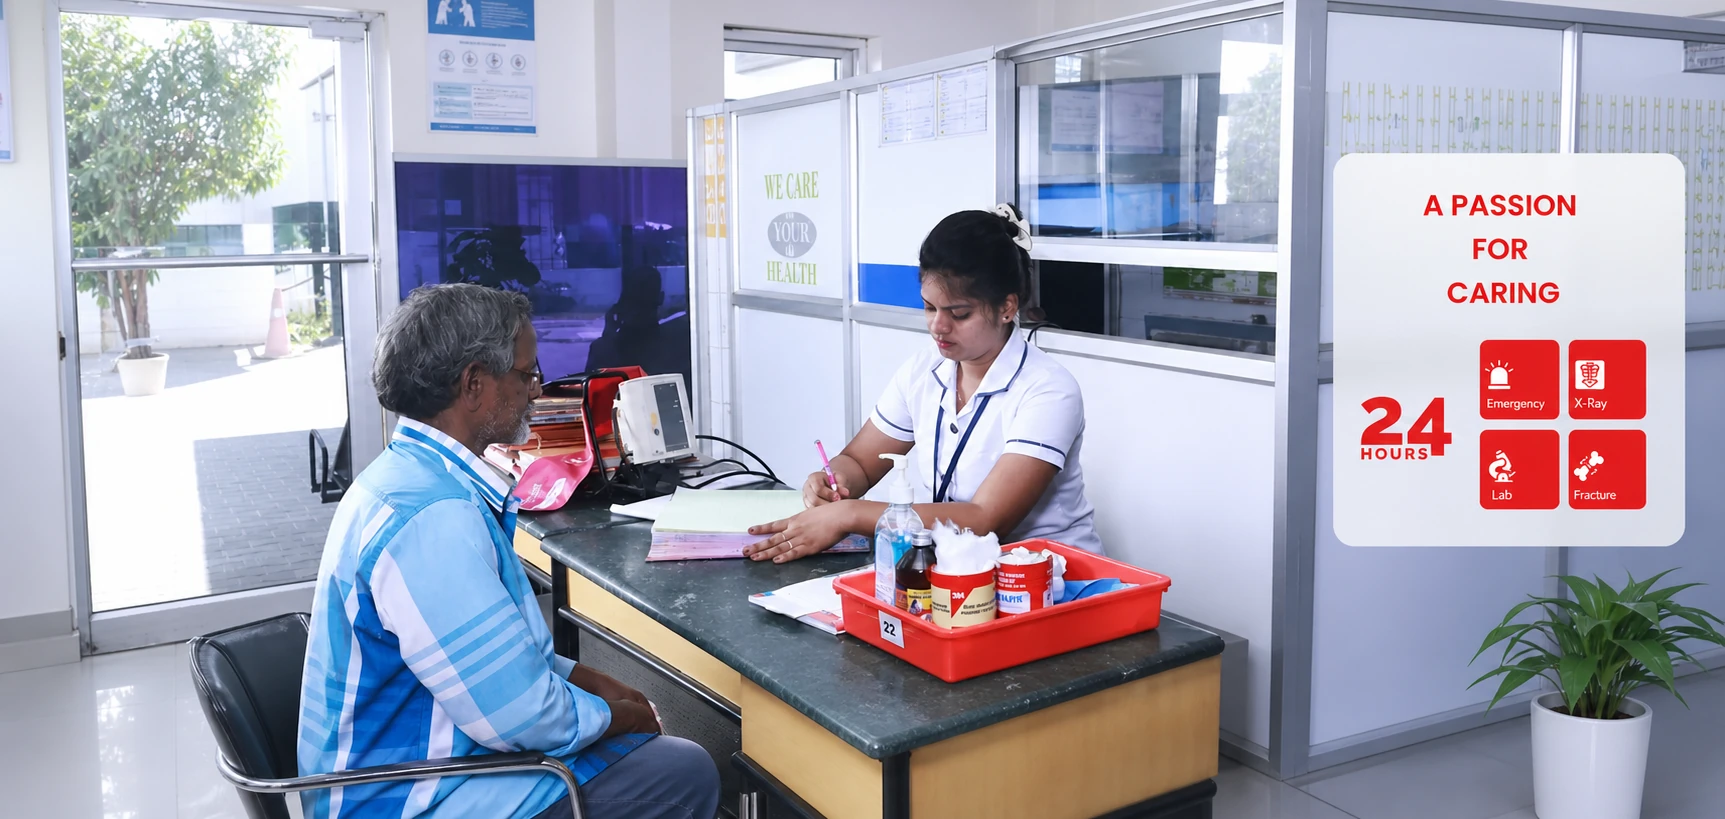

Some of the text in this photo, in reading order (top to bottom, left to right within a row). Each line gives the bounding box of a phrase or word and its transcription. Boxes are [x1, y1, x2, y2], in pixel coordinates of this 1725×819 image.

[764, 171, 819, 200] WE CARE
[773, 221, 810, 243] YOUR
[766, 260, 818, 286] HEALTH
[883, 620, 897, 637] 22
